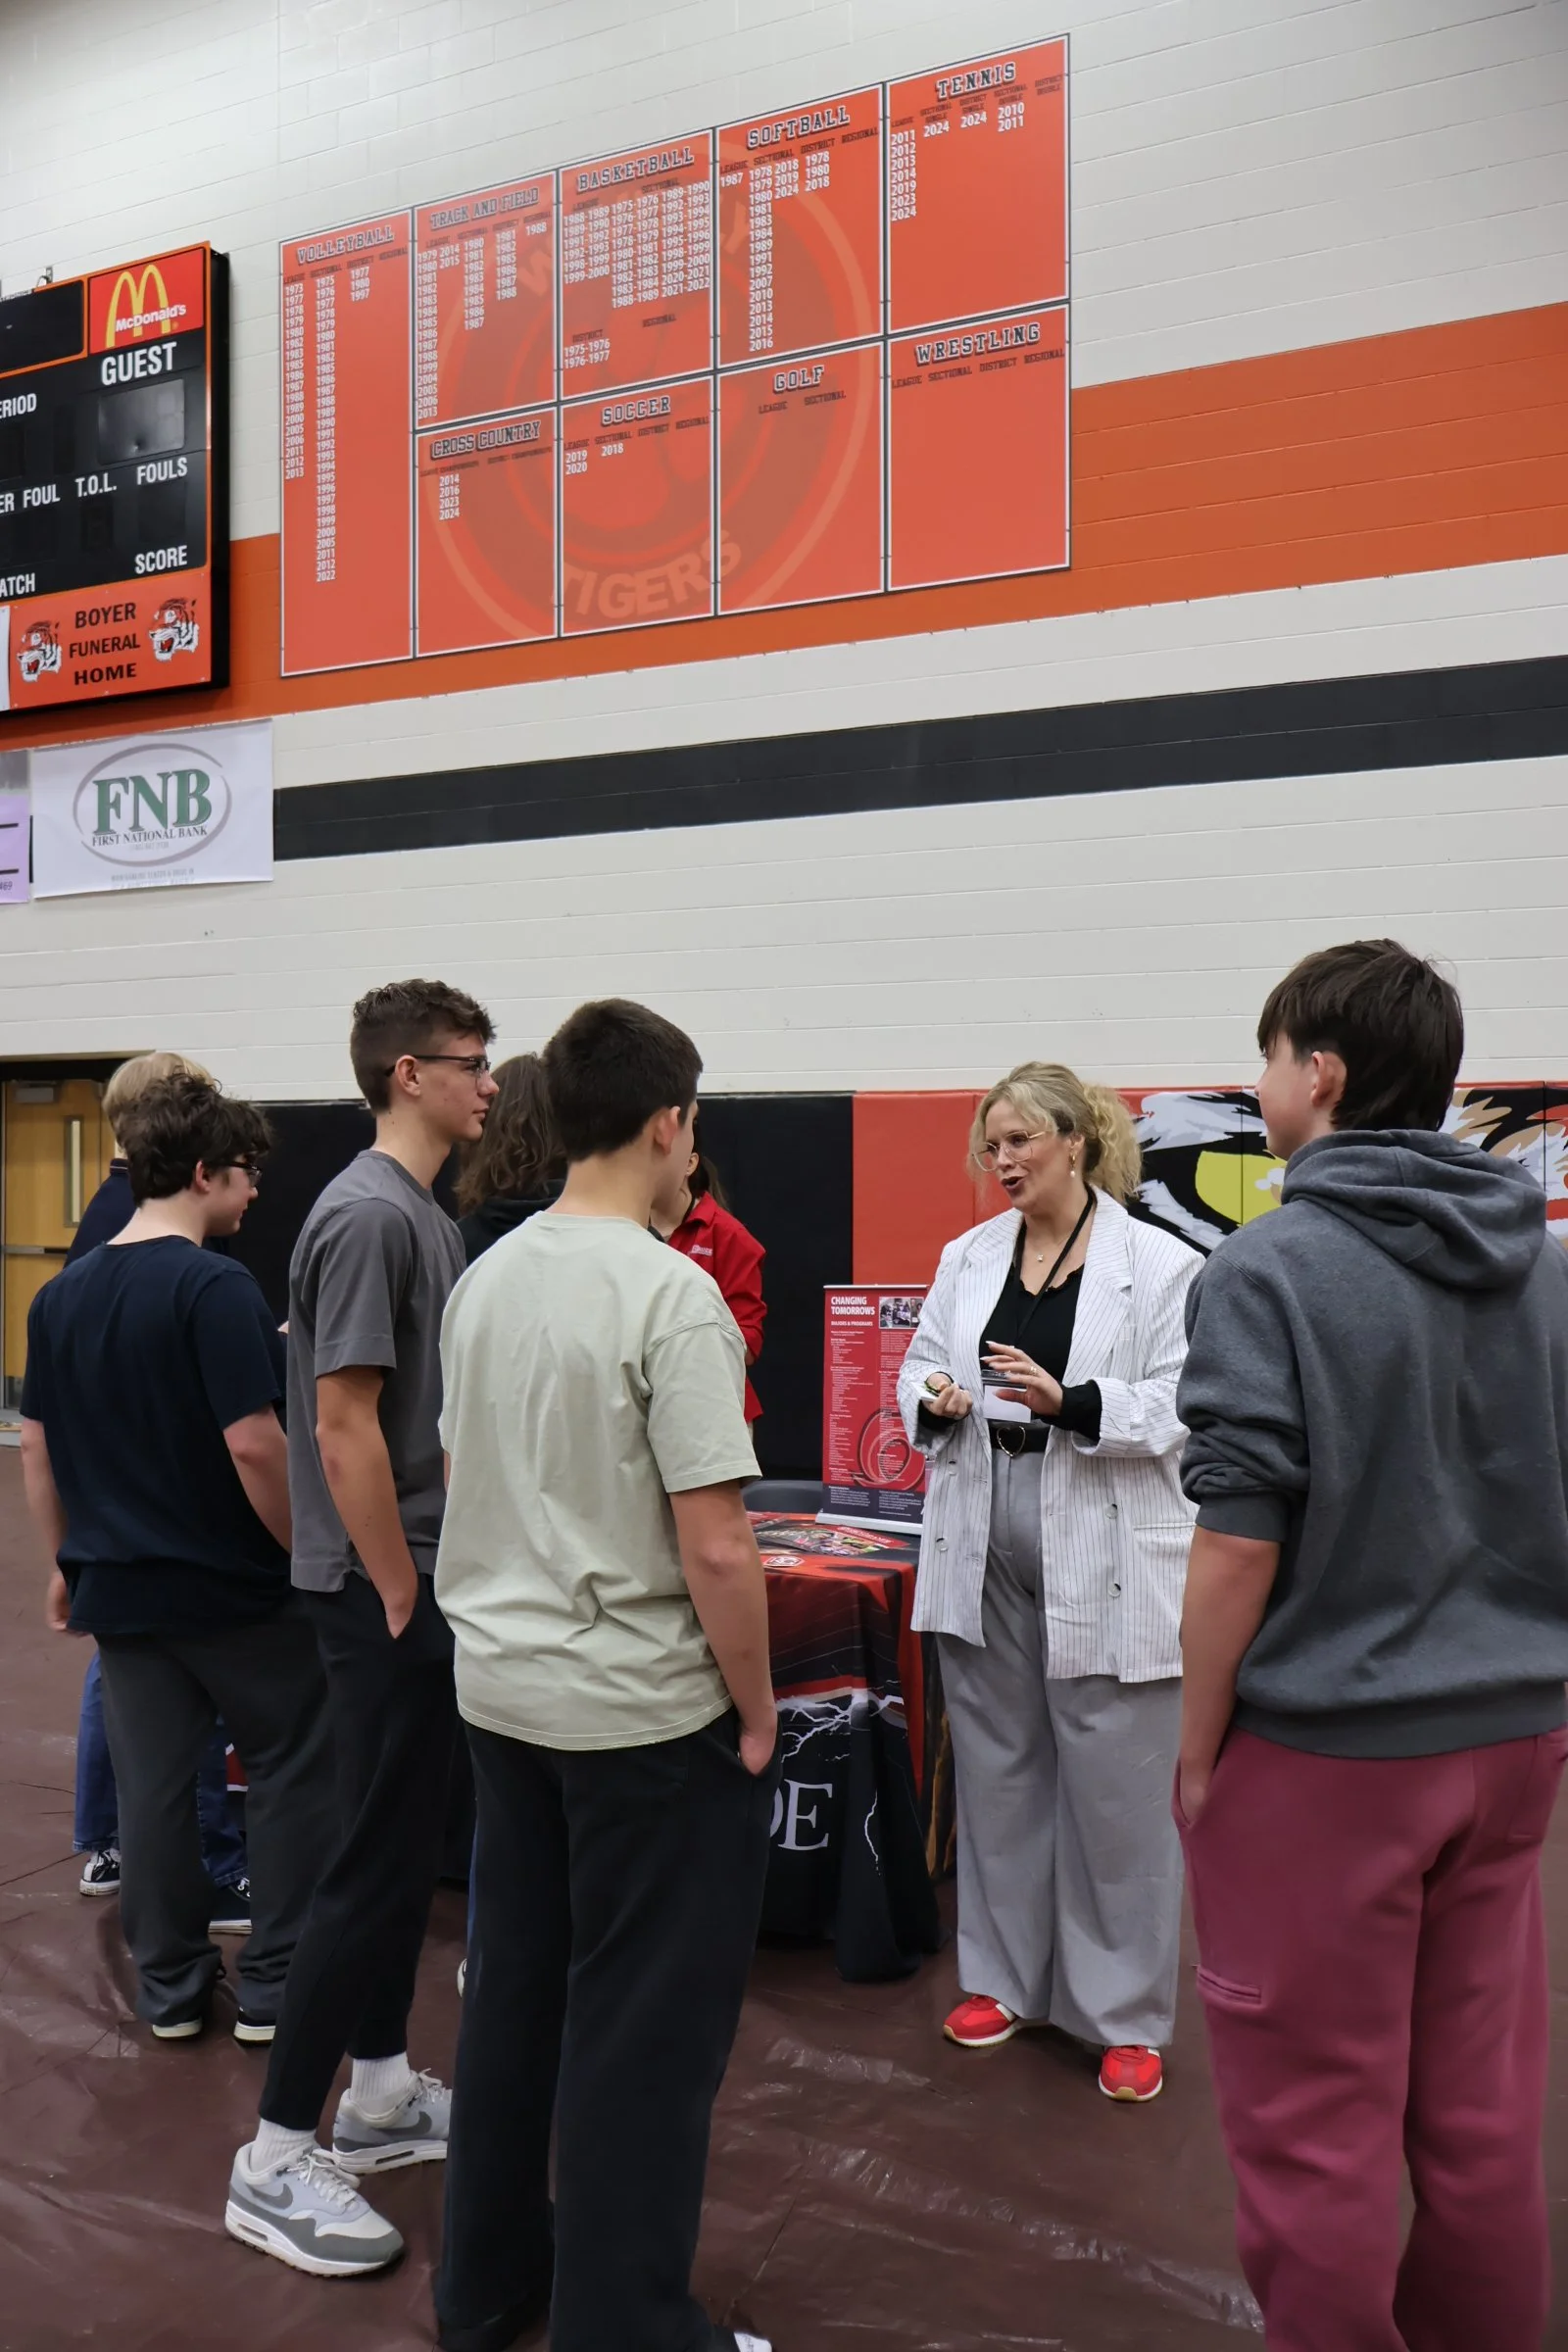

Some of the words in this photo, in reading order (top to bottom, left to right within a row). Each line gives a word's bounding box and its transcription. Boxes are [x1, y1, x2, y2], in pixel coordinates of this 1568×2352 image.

[936, 62, 1016, 101] TENNIS
[997, 102, 1025, 119] 2010
[747, 106, 851, 150] SOFTBALL
[959, 112, 987, 128] 2024
[997, 115, 1025, 132] 2011
[891, 129, 916, 145] 2011
[923, 122, 950, 138] 2024
[891, 142, 916, 158] 2012
[805, 151, 830, 167] 1978
[891, 155, 916, 171] 2013
[577, 147, 695, 194] BASKETBALL
[749, 166, 772, 181] 1978
[774, 160, 799, 175] 2018
[805, 164, 830, 179] 1980
[891, 168, 916, 183] 2014
[720, 172, 744, 188] 1987
[749, 178, 772, 193] 1979
[774, 172, 799, 187] 2019
[805, 176, 830, 192] 2018
[891, 179, 916, 196] 2019
[749, 190, 772, 206] 1980
[774, 184, 799, 200] 2024
[431, 205, 469, 230] TRACK
[472, 198, 498, 221] AND
[501, 187, 539, 213] FIELD
[612, 194, 659, 214] 1975-1976
[662, 193, 710, 214] 1992-1993
[891, 192, 916, 209] 2023
[612, 206, 659, 226] 1976-1977
[662, 206, 710, 225] 1993-1994
[749, 202, 772, 218] 1981
[891, 205, 916, 221] 2024
[612, 218, 659, 238] 1977-1978
[749, 215, 772, 230] 1983
[612, 230, 659, 250] 1978-1979
[662, 230, 710, 250] 1995-1996
[749, 227, 772, 242] 1984
[297, 226, 395, 265] VOLLEYBALL
[439, 243, 460, 258] 2014
[662, 242, 710, 262] 1998-1999
[749, 239, 772, 255] 1989
[417, 251, 438, 263] 1979
[439, 255, 460, 269] 2015
[662, 254, 710, 273] 1999-2000
[749, 251, 772, 267] 1991
[350, 267, 370, 280] 1977
[662, 267, 710, 285] 2020-2021
[749, 264, 772, 279] 1992
[662, 278, 710, 297] 2021-2022
[749, 276, 772, 291] 2007
[286, 295, 304, 307] 1977
[350, 288, 370, 302] 1997
[749, 288, 772, 304] 2010
[317, 298, 335, 311] 1977
[749, 300, 772, 316] 2013
[116, 304, 187, 332] McDonald's
[749, 313, 772, 328] 2014
[749, 325, 772, 340] 2015
[564, 338, 611, 358] 1975-1976
[749, 337, 772, 353] 2016
[915, 322, 1041, 367] WRESTLING
[101, 341, 177, 386] GUEST
[564, 350, 611, 369] 1976-1977
[417, 364, 438, 376] 1999
[773, 366, 824, 394] GOLF
[0, 393, 37, 419] RIOD
[601, 396, 671, 428] SOCCER
[417, 409, 438, 421] 2013
[430, 435, 473, 461] CROSS
[475, 421, 540, 452] COUNTRY
[286, 446, 304, 458] 2011
[565, 449, 588, 464] 2019
[601, 442, 624, 457] 2018
[286, 457, 304, 468] 2012
[565, 461, 588, 475] 2020
[137, 457, 188, 485] FOULS
[286, 467, 304, 480] 2013
[75, 473, 118, 497] T.O.L.
[439, 474, 460, 487] 2014
[24, 484, 61, 509] FOUL
[439, 485, 460, 498] 2016
[317, 494, 335, 507] 1997
[439, 497, 460, 510] 2023
[439, 509, 460, 521] 2024
[135, 545, 188, 574] SCORE
[317, 549, 335, 561] 2011
[317, 560, 335, 572] 2012
[74, 602, 137, 629] BOYER
[69, 633, 141, 659] FUNERAL
[74, 662, 138, 685] HOME
[92, 768, 213, 836] FNB
[92, 833, 122, 847] FIRST
[123, 828, 175, 845] NATIONAL
[177, 825, 208, 841] BANK
[831, 1297, 866, 1305] CHANGING
[831, 1306, 875, 1315] TOMORROWS
